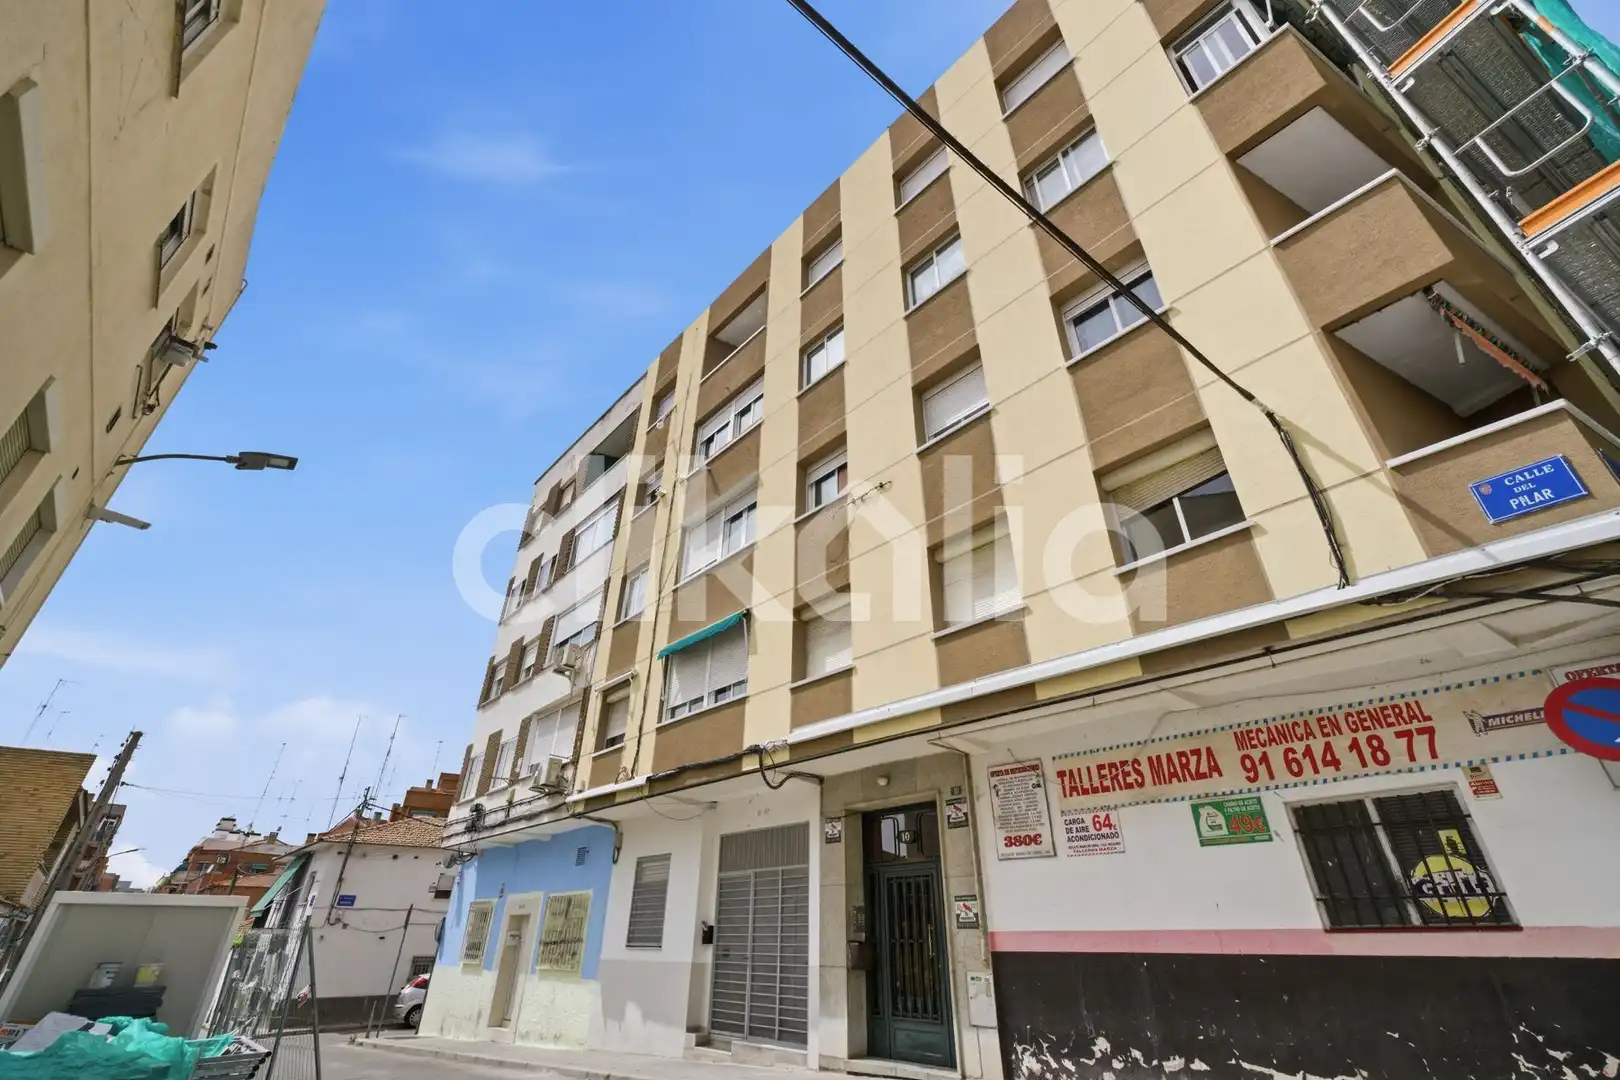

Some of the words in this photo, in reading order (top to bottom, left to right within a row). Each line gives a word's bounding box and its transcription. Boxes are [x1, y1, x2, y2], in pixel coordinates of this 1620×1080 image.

[1504, 463, 1555, 486] CALLE
[1513, 482, 1536, 494] DEL
[1509, 487, 1555, 510] PILAR
[1316, 713, 1344, 738] EN
[1344, 700, 1433, 734] GENERAL
[1488, 710, 1545, 727] MICHELI
[1240, 750, 1275, 784] 91
[1283, 740, 1342, 778] 614
[1348, 734, 1391, 769] 18
[1393, 725, 1439, 762] 77
[1056, 758, 1146, 798] TALLERES
[1147, 746, 1223, 786] MARZA
[1064, 817, 1086, 826] CARGA
[1065, 827, 1074, 835] DE
[1075, 825, 1090, 834] AIRE
[1229, 815, 1266, 833] 49€
[902, 832, 910, 842] 10
[1004, 833, 1043, 848] 380€
[1067, 832, 1120, 843] ACONDICIONADO
